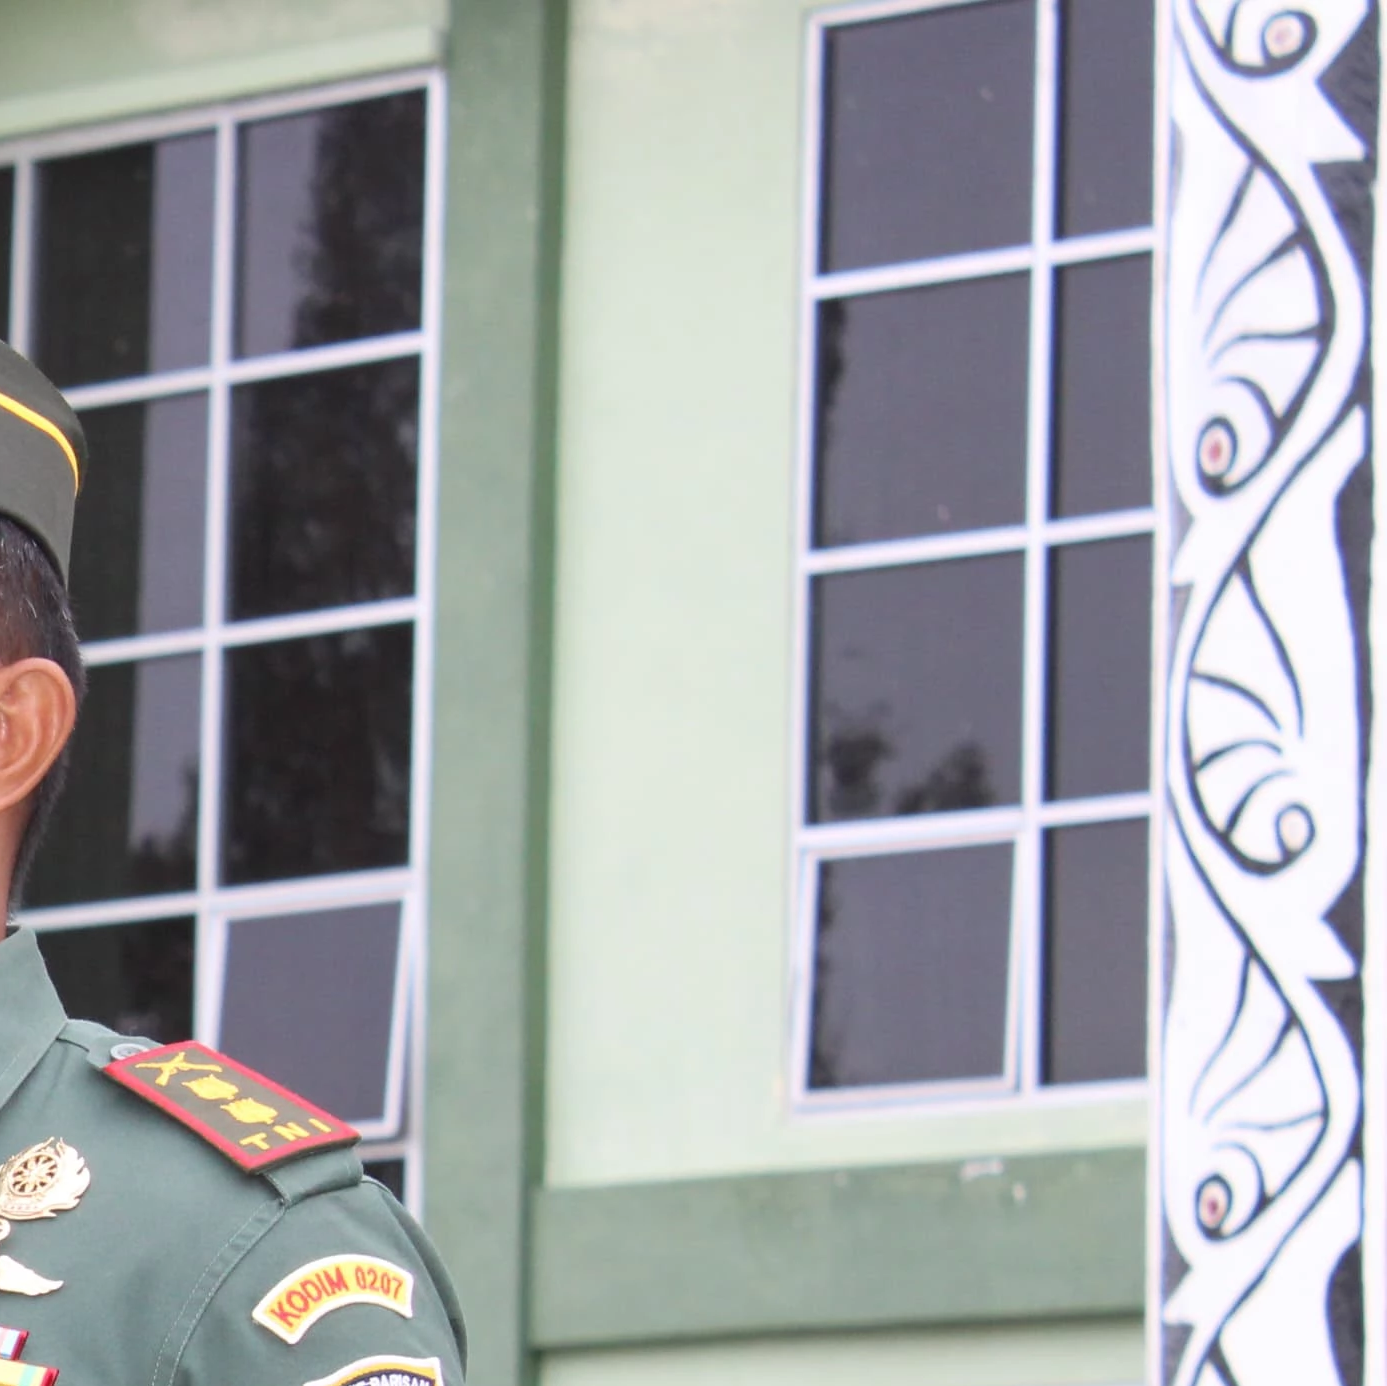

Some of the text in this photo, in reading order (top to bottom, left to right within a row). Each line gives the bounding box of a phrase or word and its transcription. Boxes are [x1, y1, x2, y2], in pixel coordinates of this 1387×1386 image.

[239, 1117, 333, 1151] TNI
[271, 1266, 404, 1328] KODIM 0207
